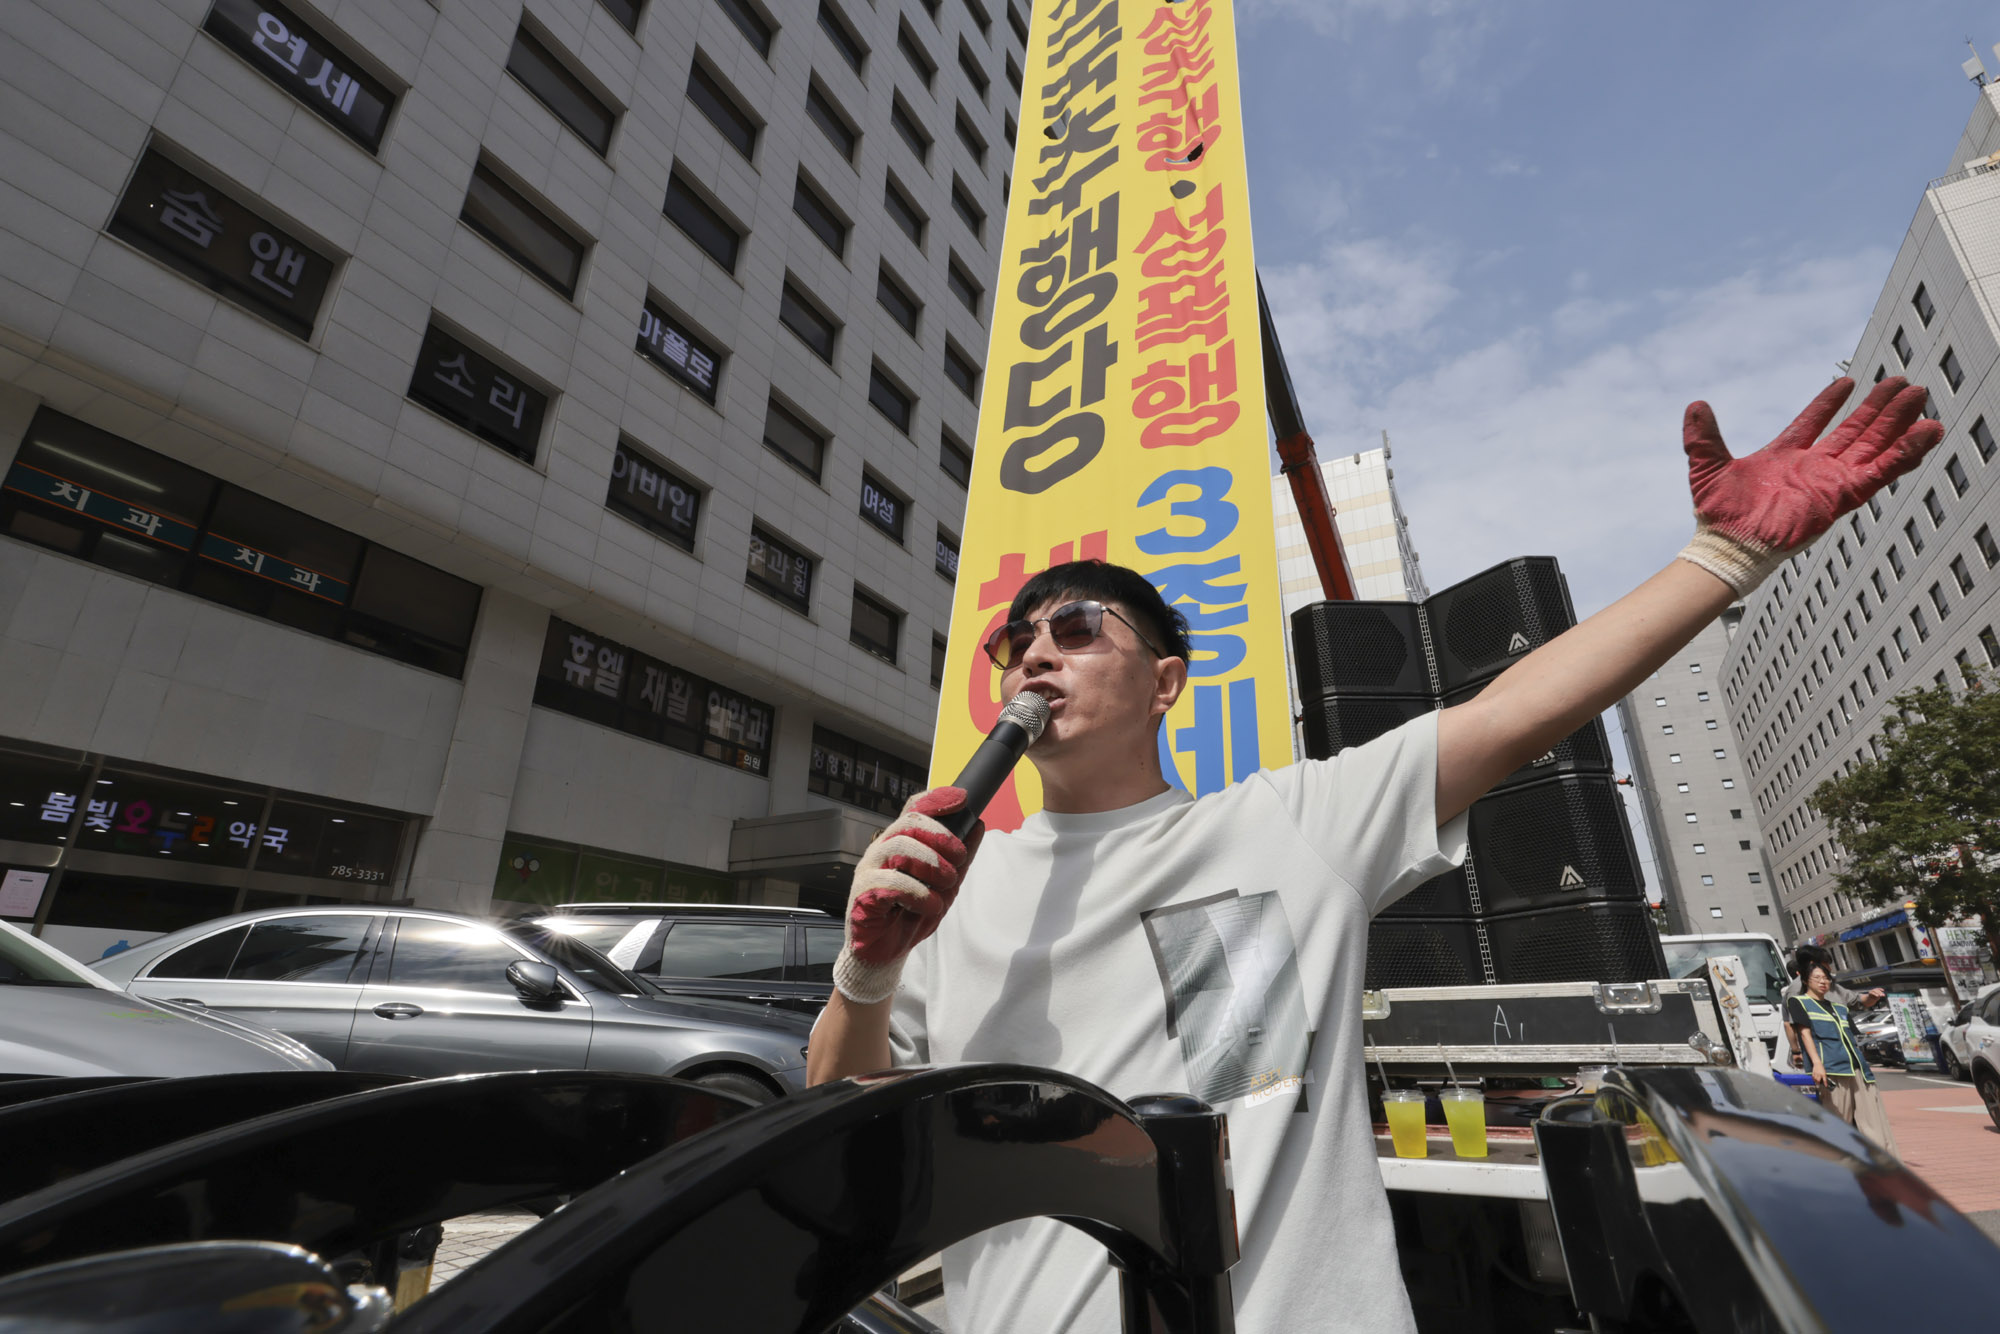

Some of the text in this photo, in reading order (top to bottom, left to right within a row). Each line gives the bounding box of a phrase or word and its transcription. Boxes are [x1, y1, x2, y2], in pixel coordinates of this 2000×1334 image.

[252, 12, 361, 115] 연세
[639, 308, 714, 389] 아폴로
[863, 484, 894, 525] 여성
[433, 354, 526, 428] 소리
[611, 450, 696, 527] 이비인
[50, 481, 321, 593] 치과 치과
[561, 633, 625, 699] 휴엘
[743, 754, 761, 770] 의원
[330, 863, 385, 881] 785-3331
[1250, 1066, 1282, 1088] ARTY
